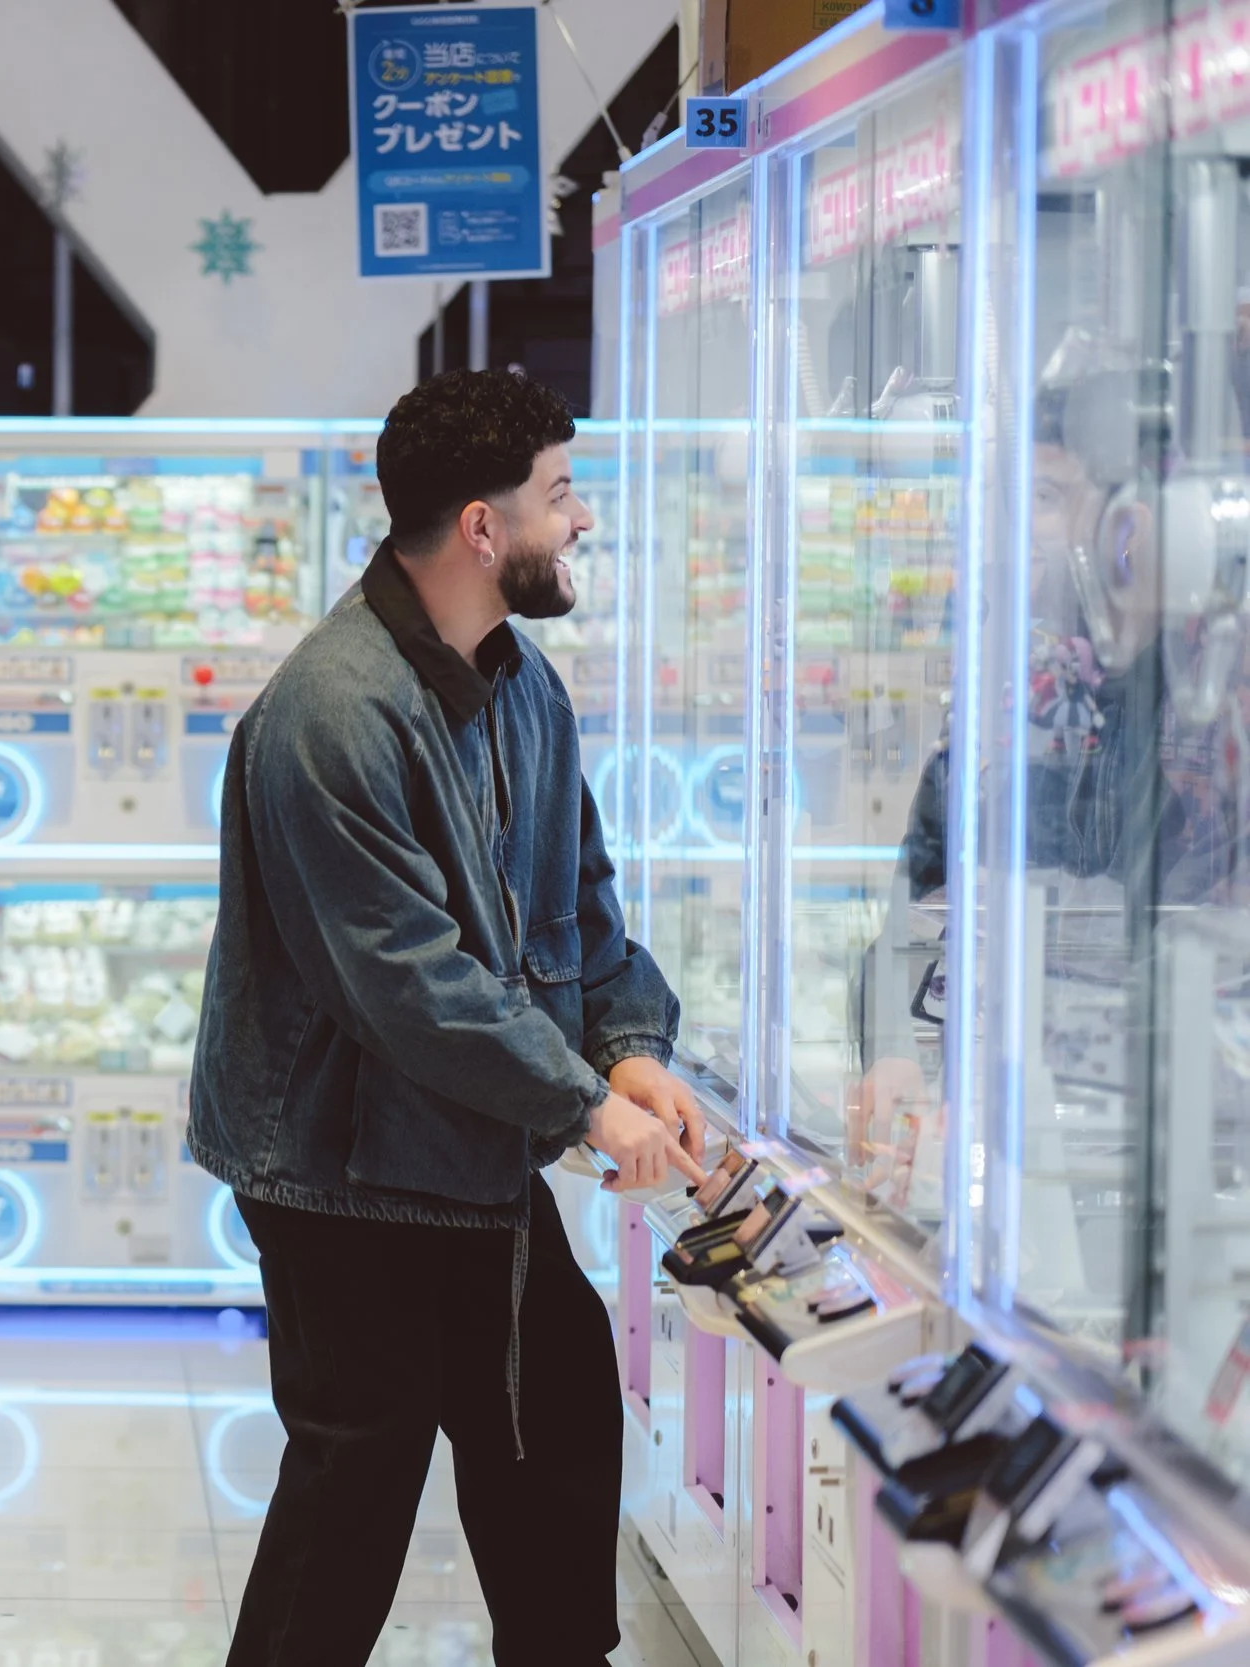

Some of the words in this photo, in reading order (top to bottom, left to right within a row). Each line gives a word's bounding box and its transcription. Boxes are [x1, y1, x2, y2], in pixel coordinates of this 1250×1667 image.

[424, 41, 521, 69] 当店について
[373, 90, 479, 120] クーポン
[695, 108, 738, 137] 35
[373, 121, 522, 154] プレゼント
